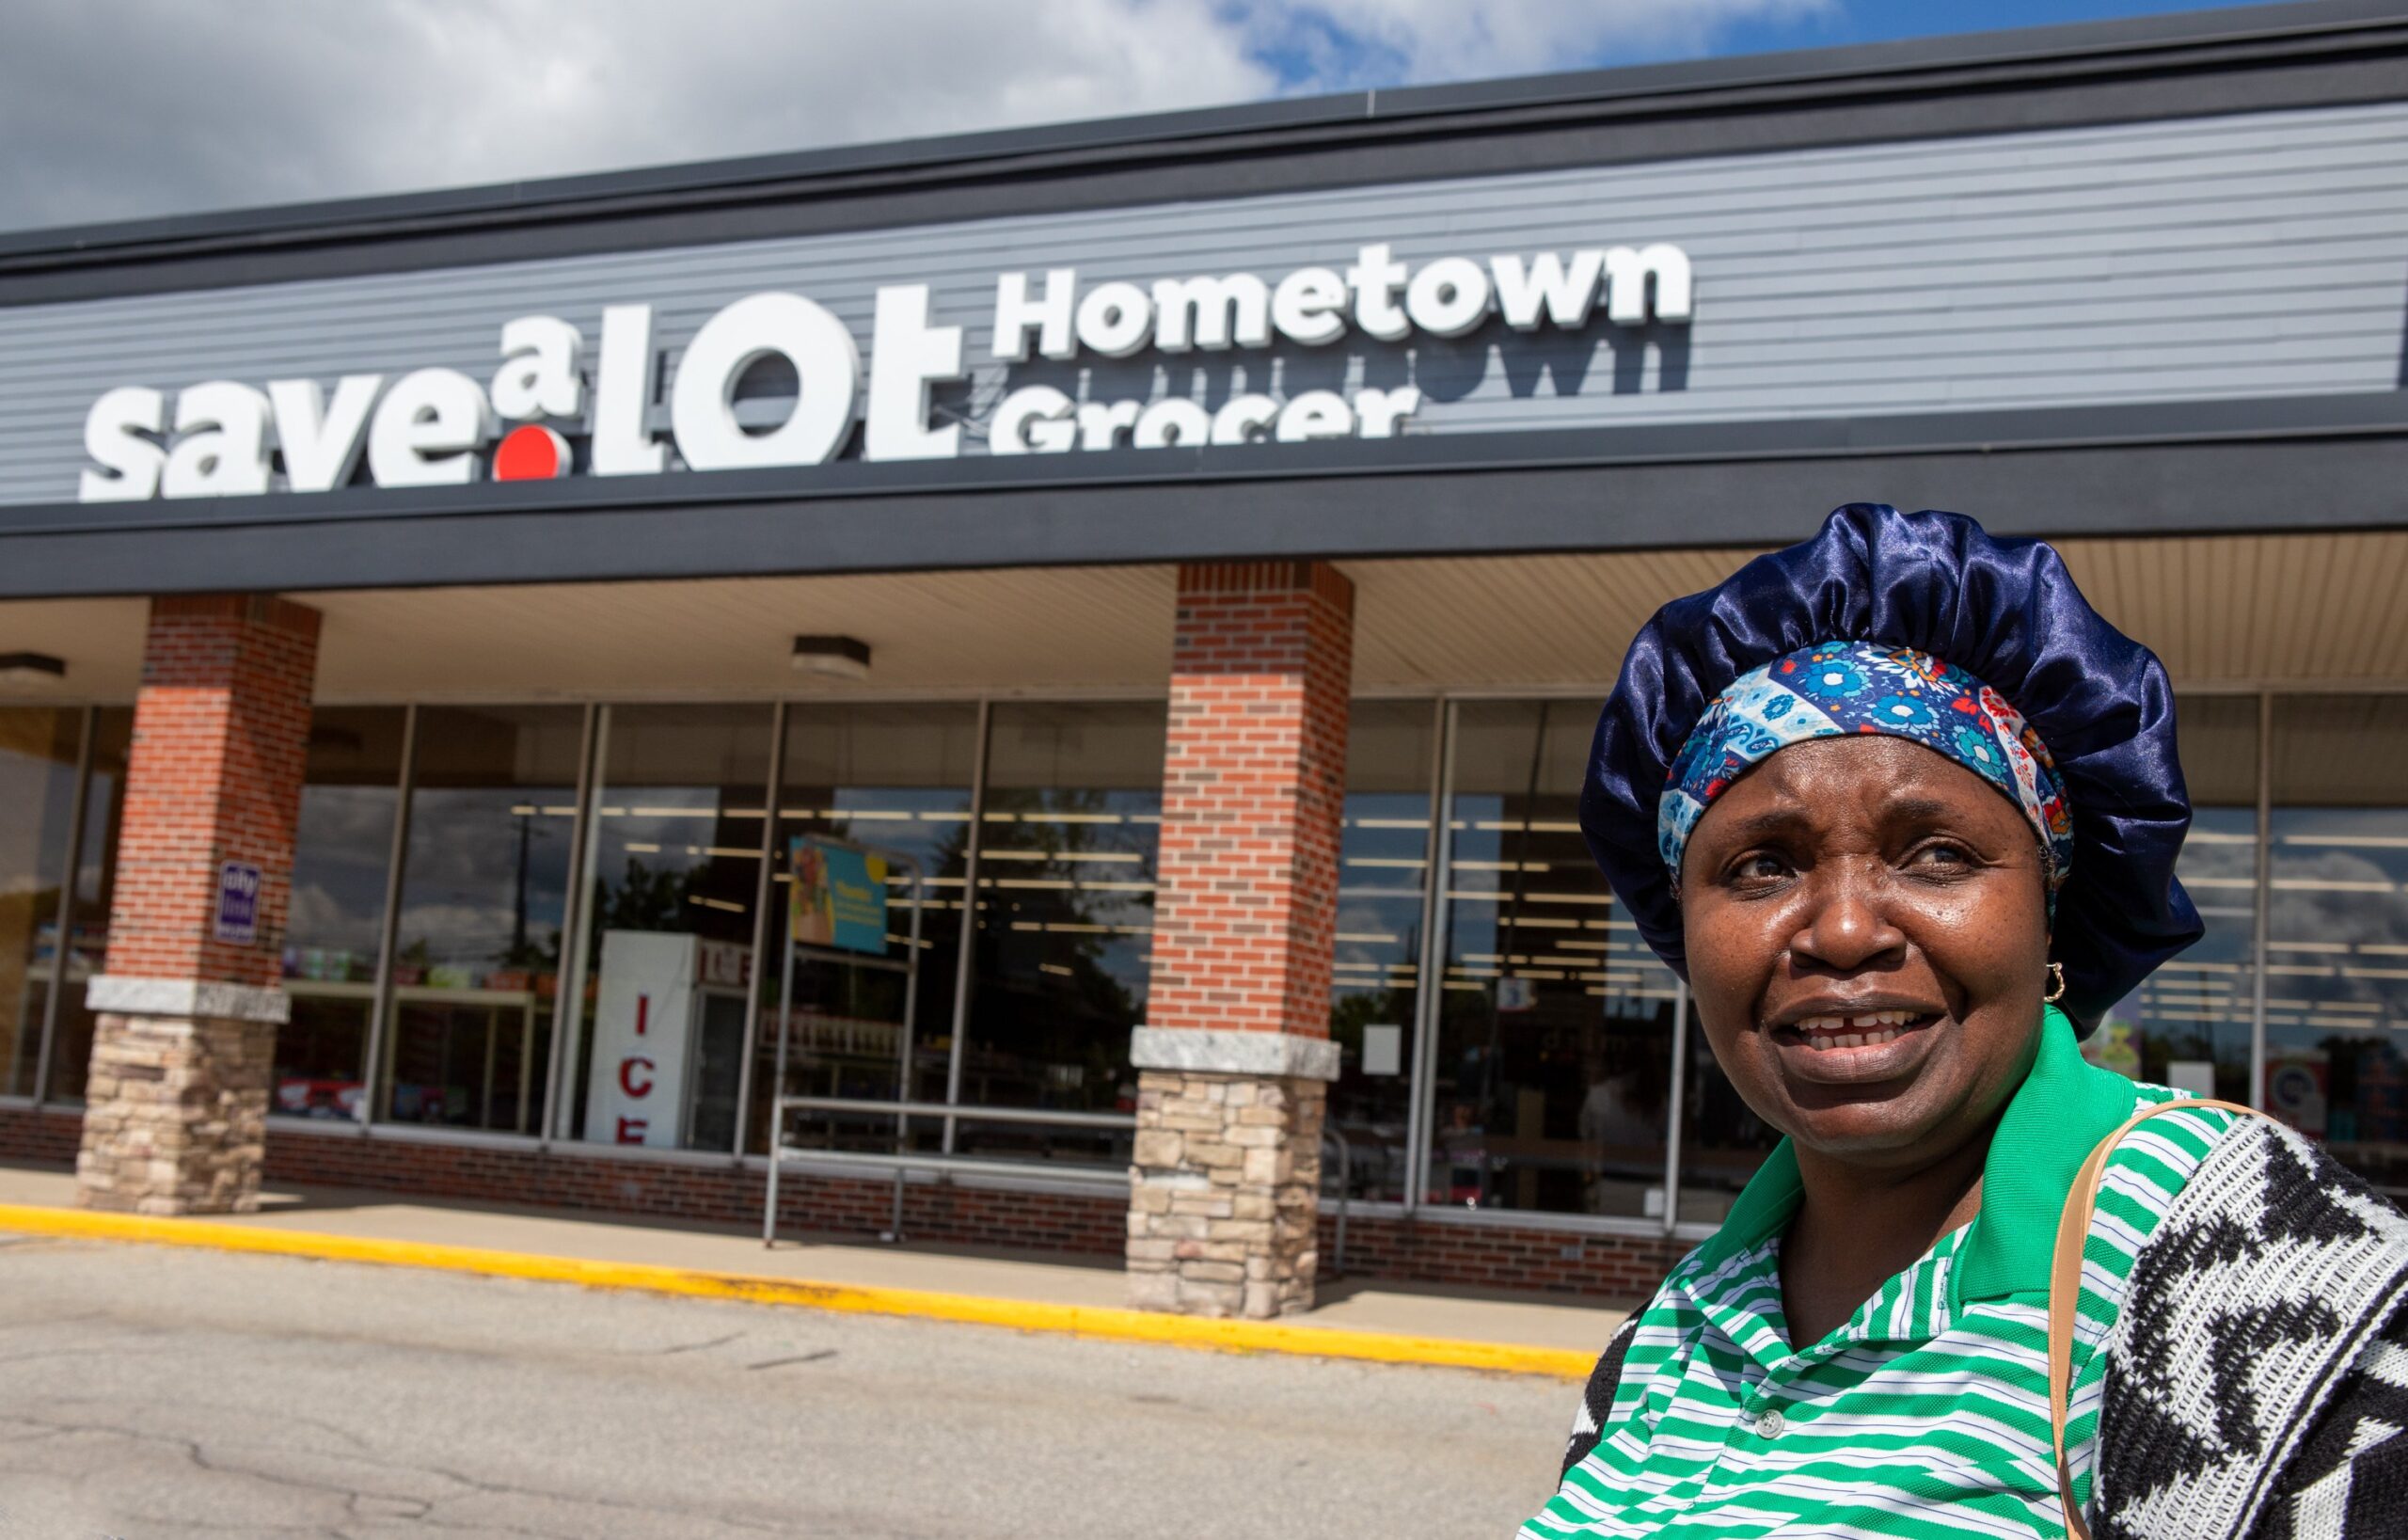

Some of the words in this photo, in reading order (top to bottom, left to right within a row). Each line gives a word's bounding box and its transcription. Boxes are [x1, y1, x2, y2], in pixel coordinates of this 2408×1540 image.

[990, 242, 1693, 359] Hometown
[79, 367, 489, 501] save
[989, 384, 1421, 456] Grocer
